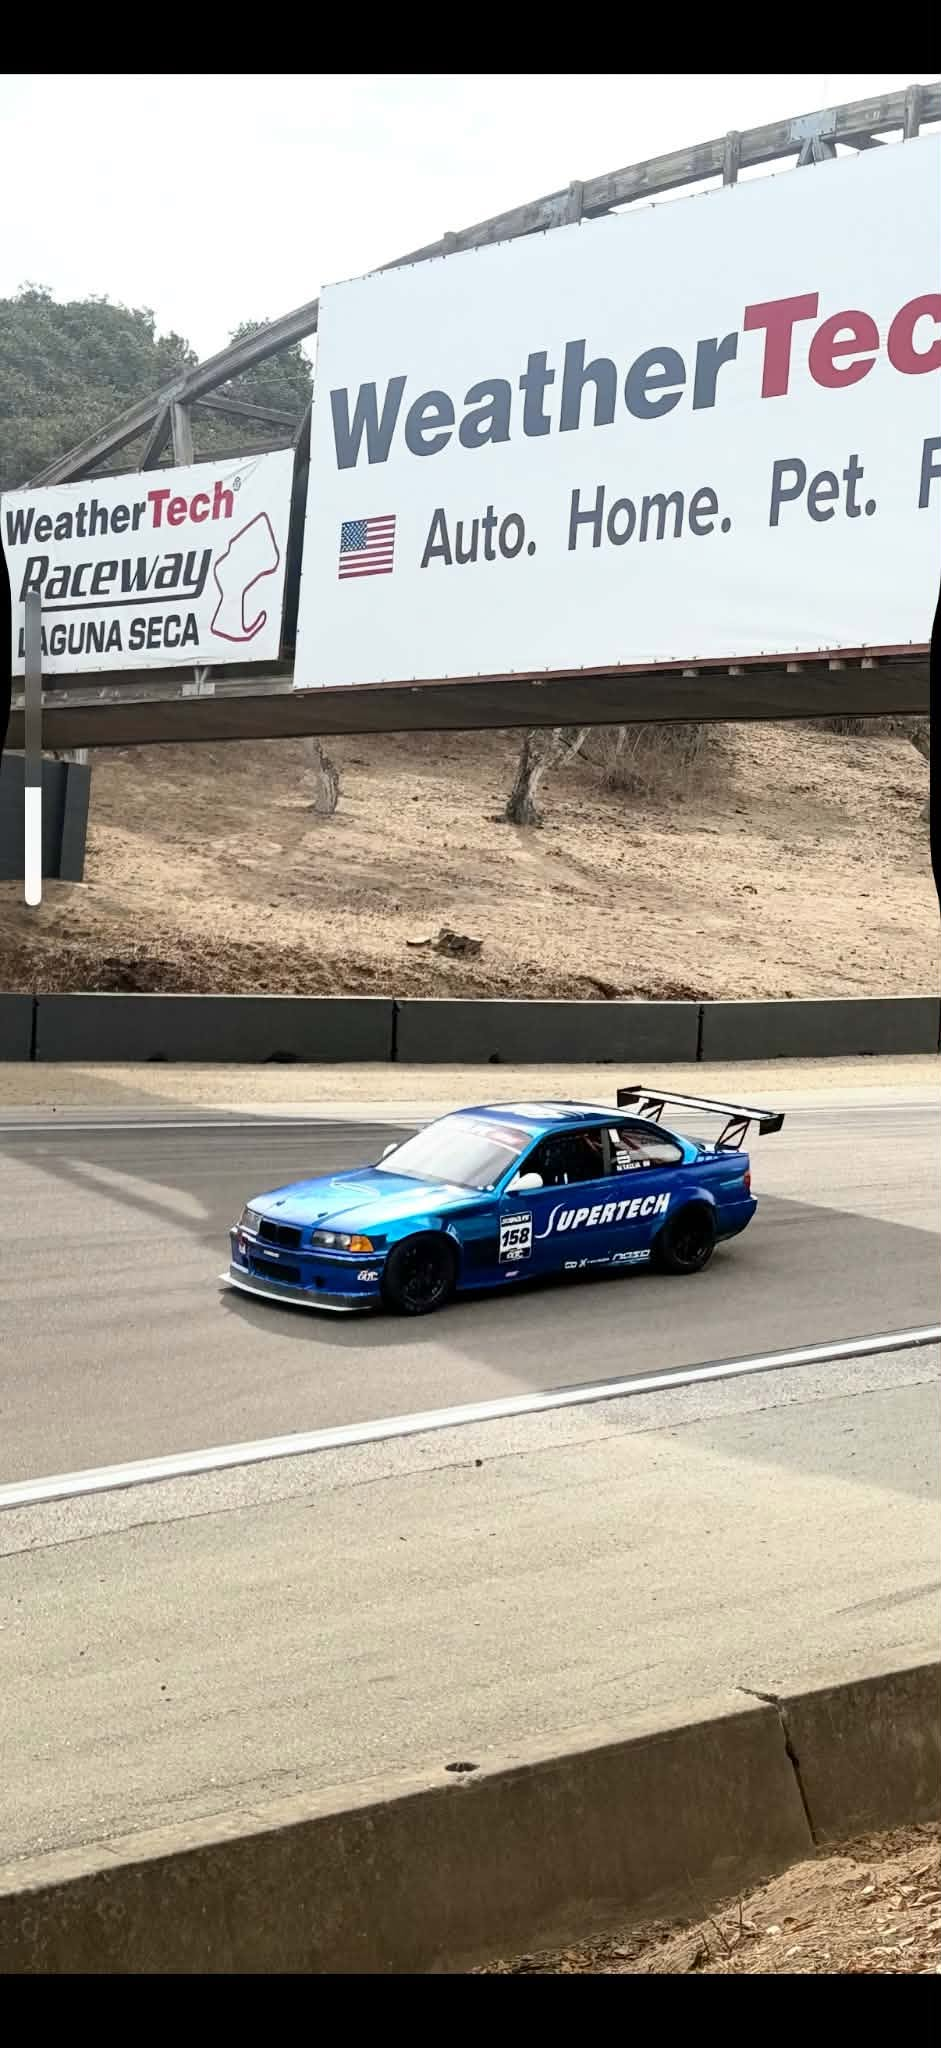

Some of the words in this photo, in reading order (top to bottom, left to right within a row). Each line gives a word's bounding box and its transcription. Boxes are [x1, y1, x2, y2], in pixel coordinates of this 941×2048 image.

[6, 480, 235, 546] WeatherTech
[420, 505, 537, 569] Auto.
[567, 485, 732, 551] Home.
[769, 454, 877, 527] Pet.
[18, 548, 213, 603] Raceway
[128, 612, 200, 651] SECA
[502, 1227, 531, 1248] 158
[534, 1192, 672, 1239] SUPERTECH
